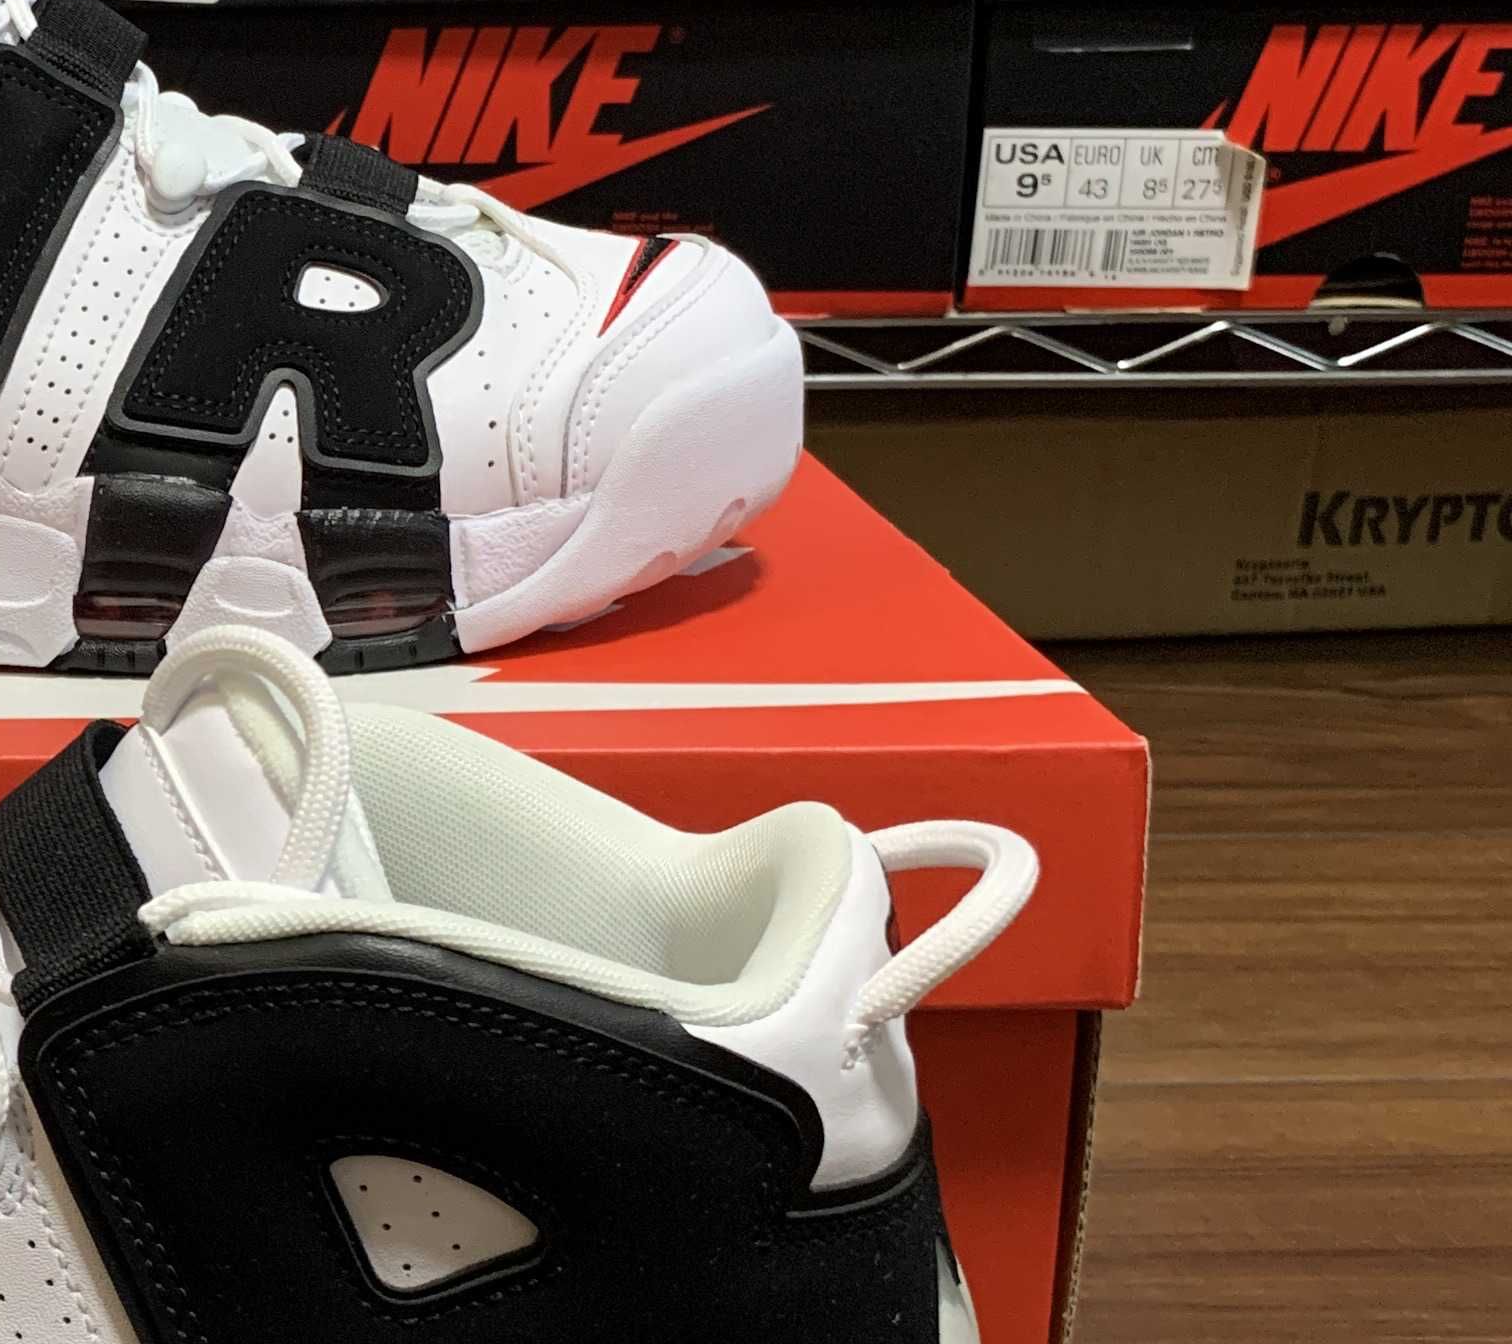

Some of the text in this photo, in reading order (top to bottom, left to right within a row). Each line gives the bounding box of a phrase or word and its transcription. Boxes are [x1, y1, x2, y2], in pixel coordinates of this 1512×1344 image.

[351, 24, 661, 165] NIKE
[1226, 23, 1512, 153] NIKE
[994, 142, 1065, 165] USA
[1074, 144, 1121, 166] EURO
[1140, 145, 1164, 166] UK
[1078, 178, 1109, 200] 43
